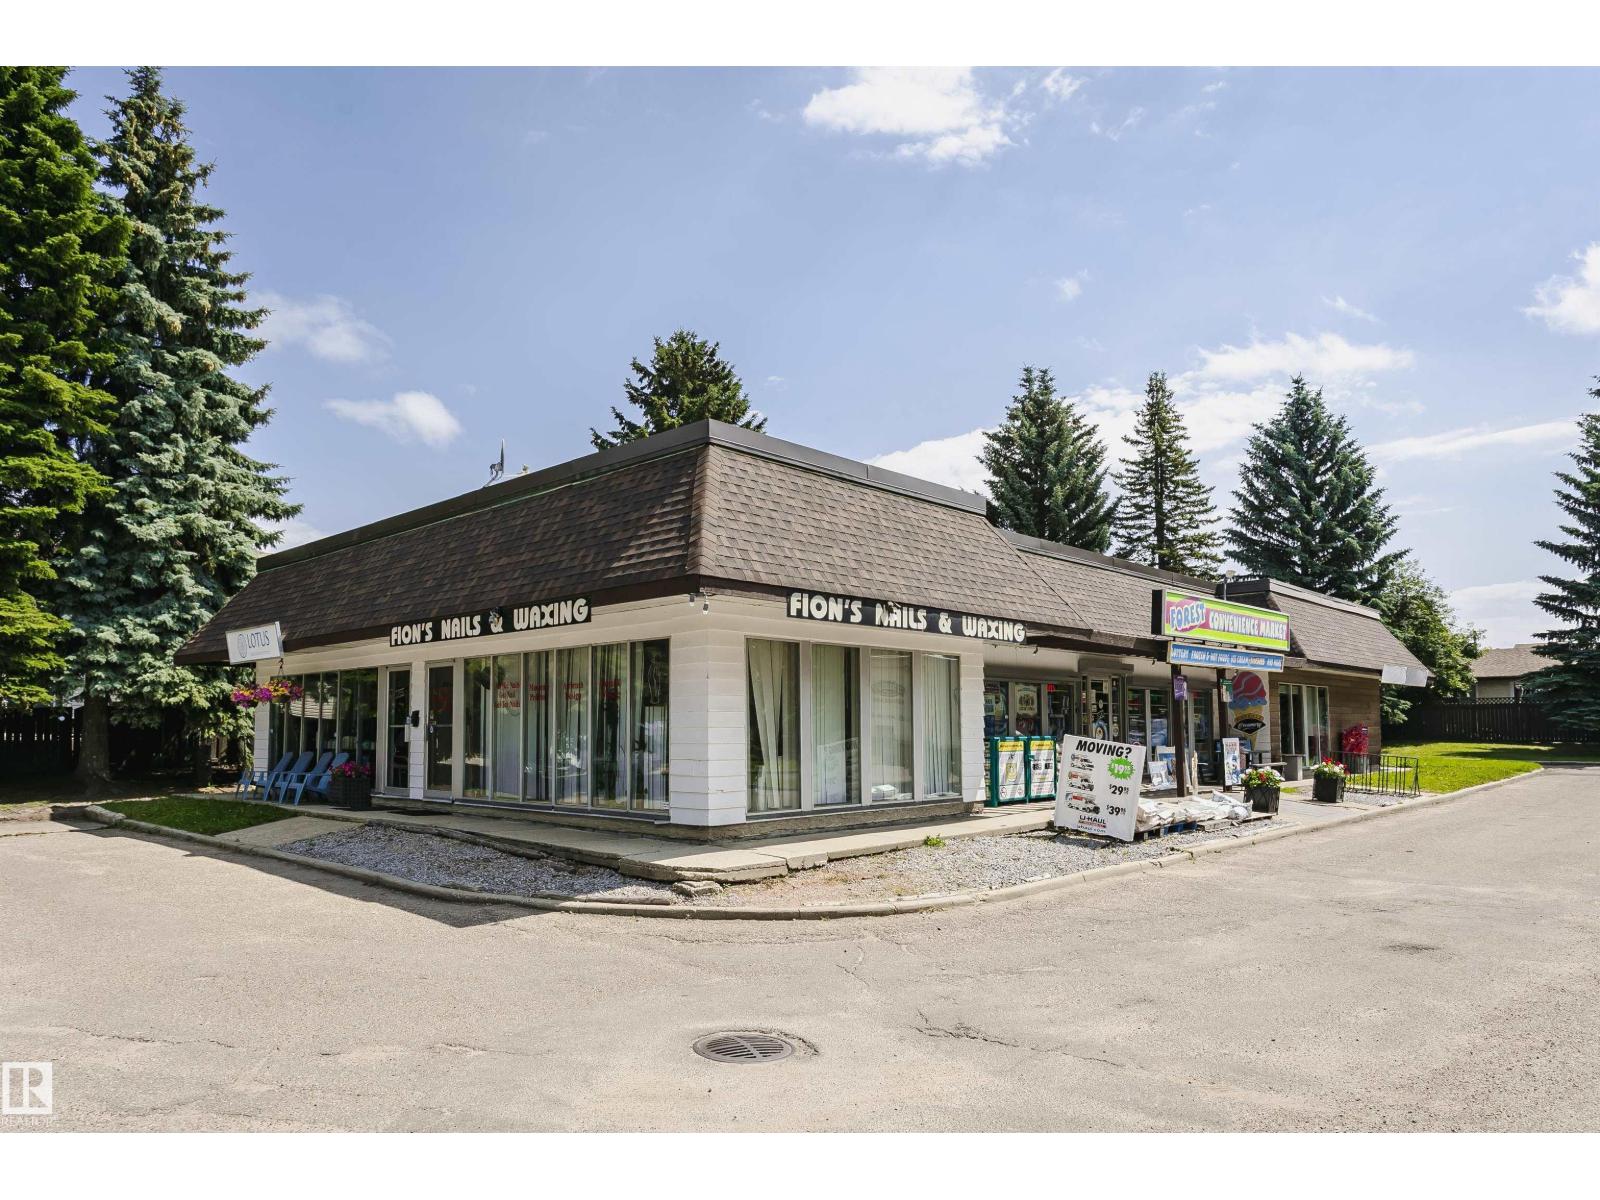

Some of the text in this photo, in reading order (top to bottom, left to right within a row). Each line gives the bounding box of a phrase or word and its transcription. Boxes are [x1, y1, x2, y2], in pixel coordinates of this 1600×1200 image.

[391, 622, 432, 646] FION'S
[441, 615, 481, 640] NAILS
[513, 598, 589, 631] WAXING
[790, 592, 1026, 642] FION'S NAILS & WAXING
[1170, 602, 1288, 640] FOREST CONVENIENCE MARKET
[247, 630, 270, 649] LOTUS
[1076, 740, 1132, 759] MOVING?
[1079, 815, 1107, 825] U-HAUL
